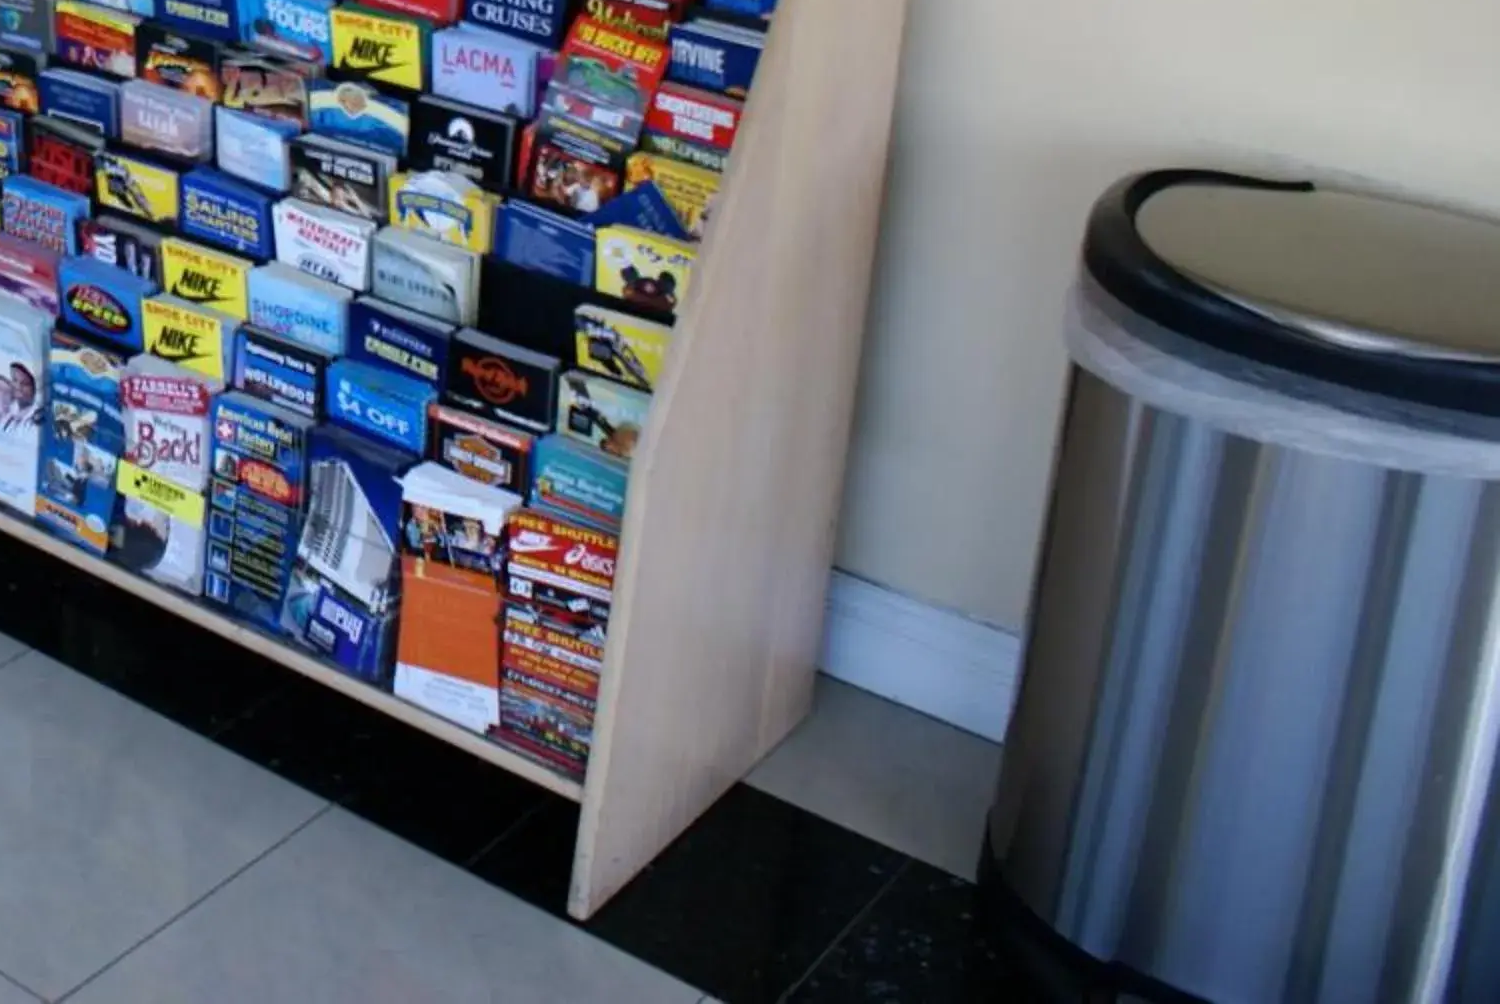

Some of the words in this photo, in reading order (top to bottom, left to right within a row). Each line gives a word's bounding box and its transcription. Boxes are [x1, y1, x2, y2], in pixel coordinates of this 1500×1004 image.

[376, 21, 413, 40] CITY
[471, 0, 552, 38] CRUISES
[349, 37, 398, 63] NIKE
[442, 44, 516, 80] LACMA
[671, 38, 725, 75] IRVINE
[185, 192, 259, 231] SAILING
[286, 211, 363, 252] WATERCRAFT
[180, 267, 222, 296] NIKE
[158, 325, 202, 354] NIKE
[366, 407, 410, 435] OFF
[551, 523, 618, 551] SHUTTLE
